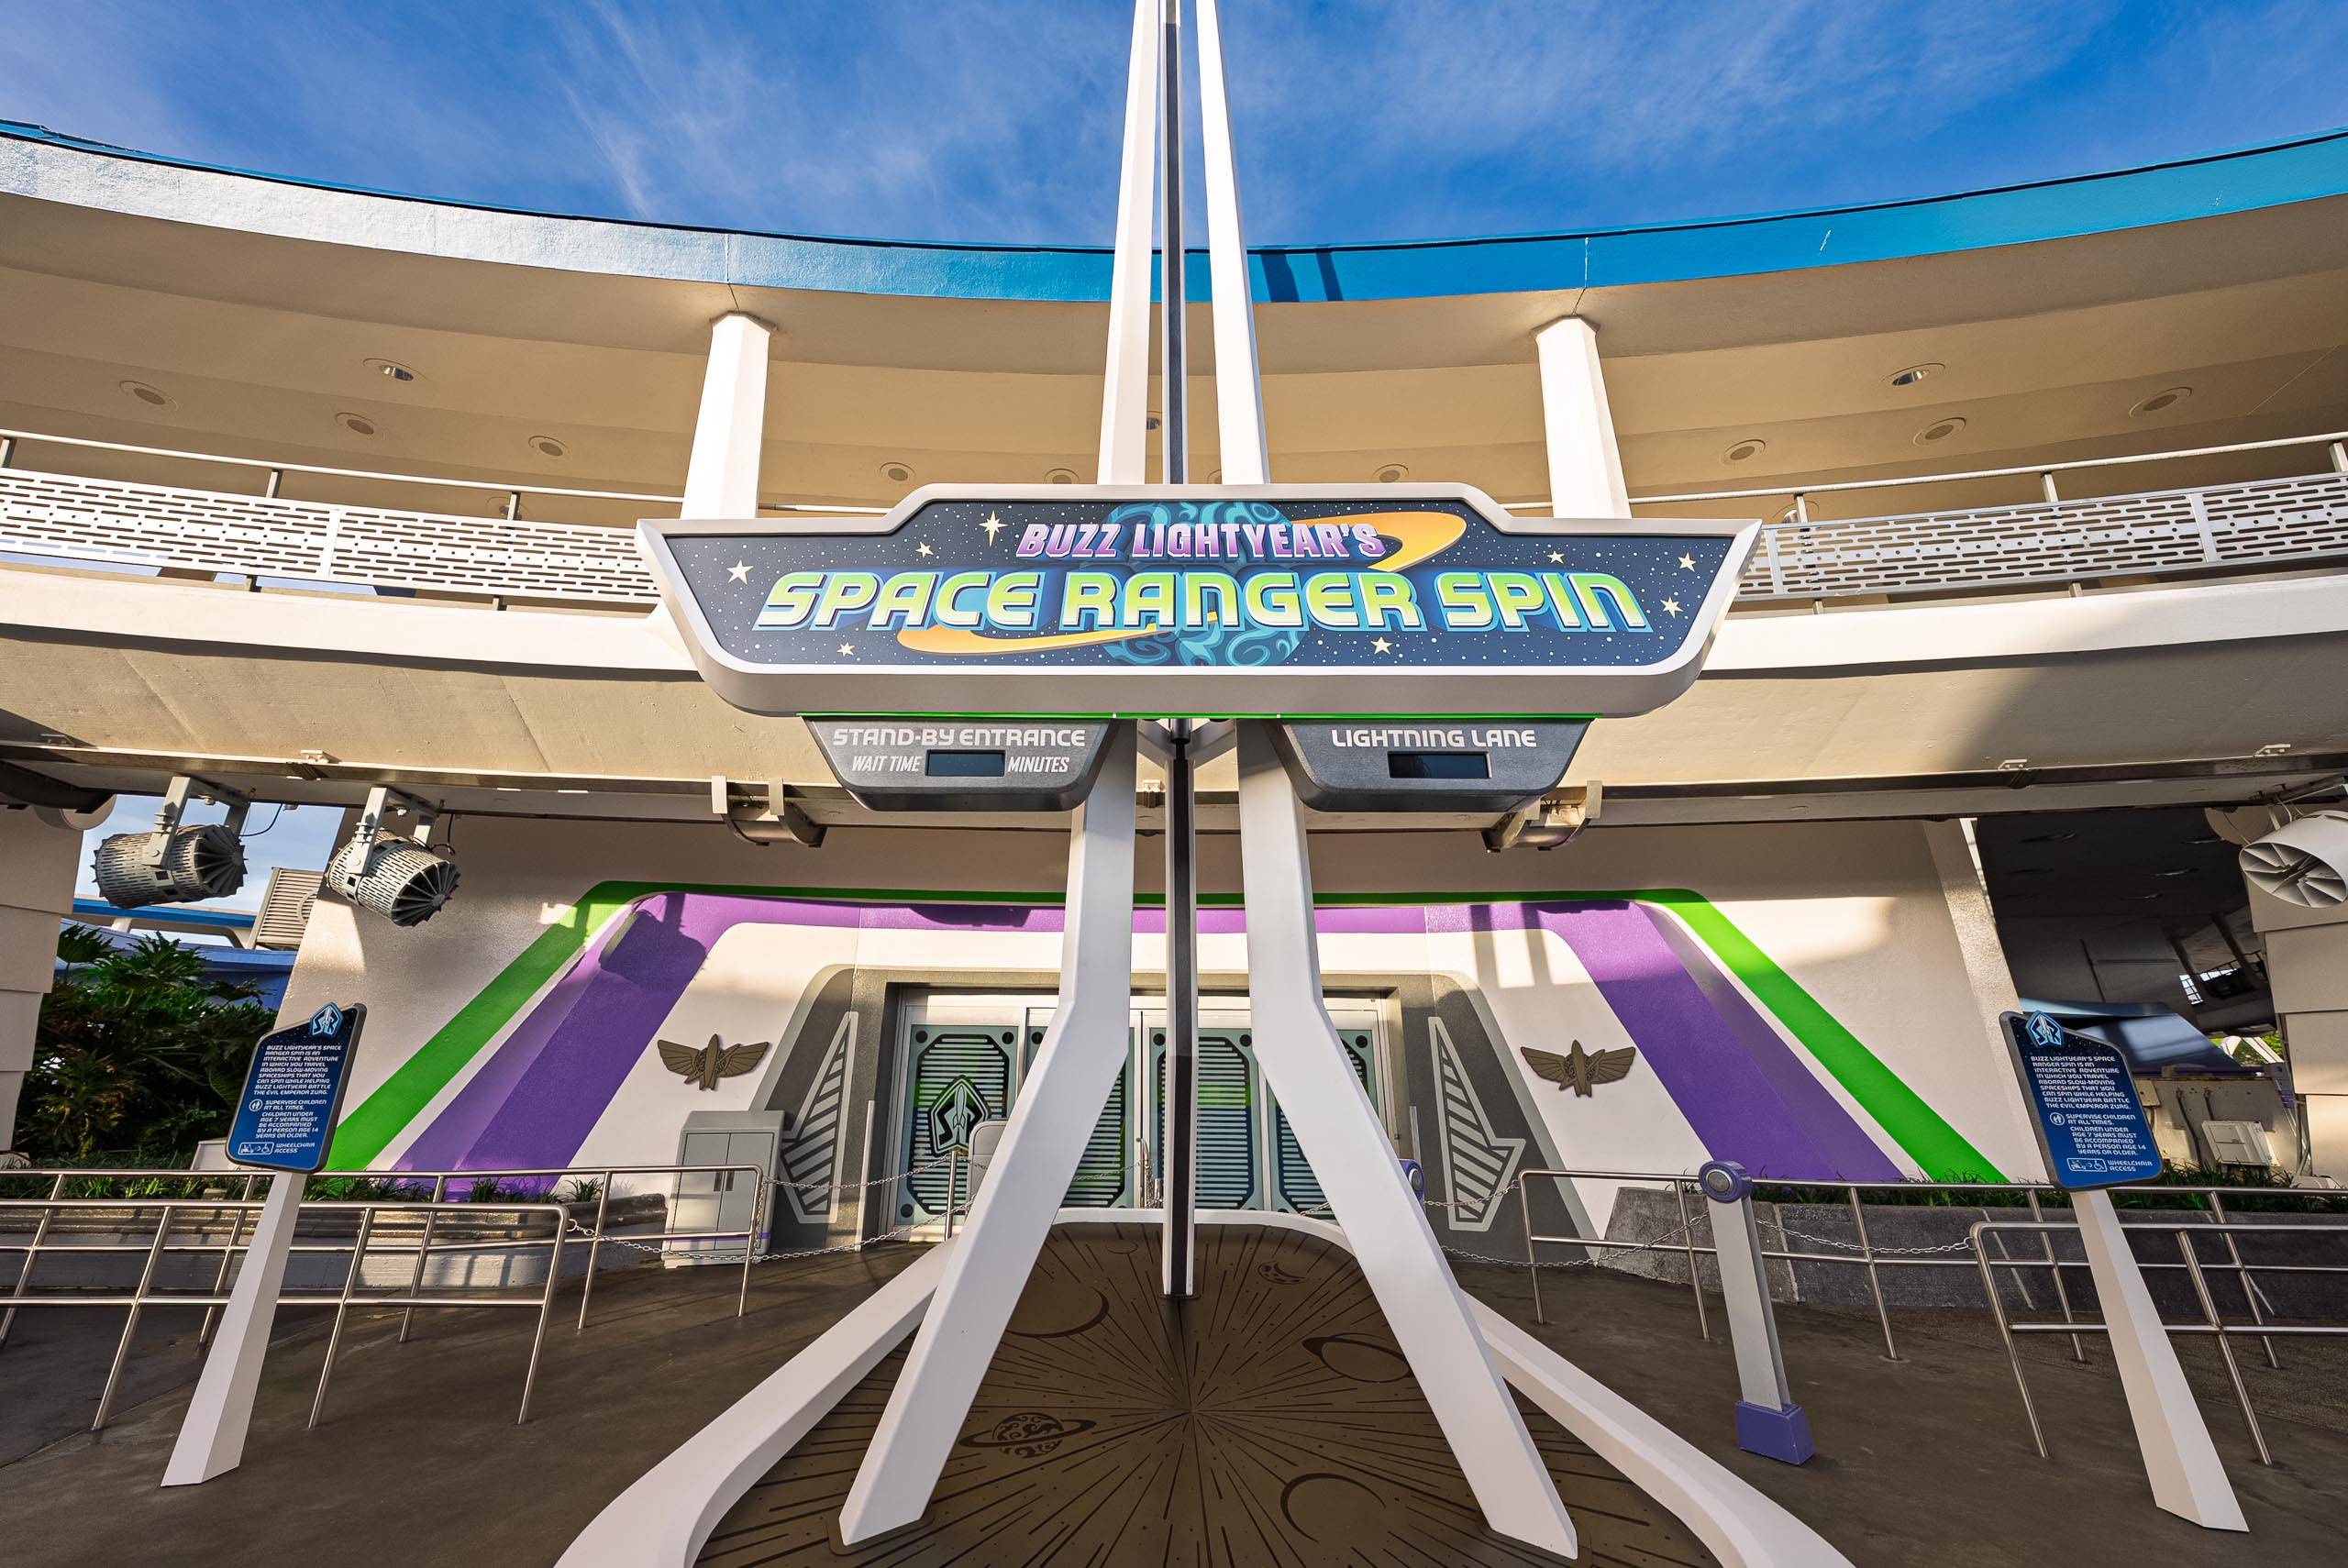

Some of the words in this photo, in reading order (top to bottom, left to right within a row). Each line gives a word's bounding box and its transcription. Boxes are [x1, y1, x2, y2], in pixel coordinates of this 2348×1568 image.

[1015, 522, 1122, 558] BUZZ
[1133, 522, 1387, 558] LIGHTYEAR'S
[753, 571, 1041, 631] SPACE
[1062, 571, 1427, 631] RANGER
[1436, 571, 1652, 631] SPIN
[833, 728, 956, 747] STAND-BY
[959, 728, 1085, 747] ENTRANCE
[1332, 729, 1465, 749] LIGHTNING
[1471, 729, 1537, 749] LANE
[851, 755, 888, 774] WAIT
[890, 755, 920, 774] TIME
[1008, 755, 1069, 774] MINUTES
